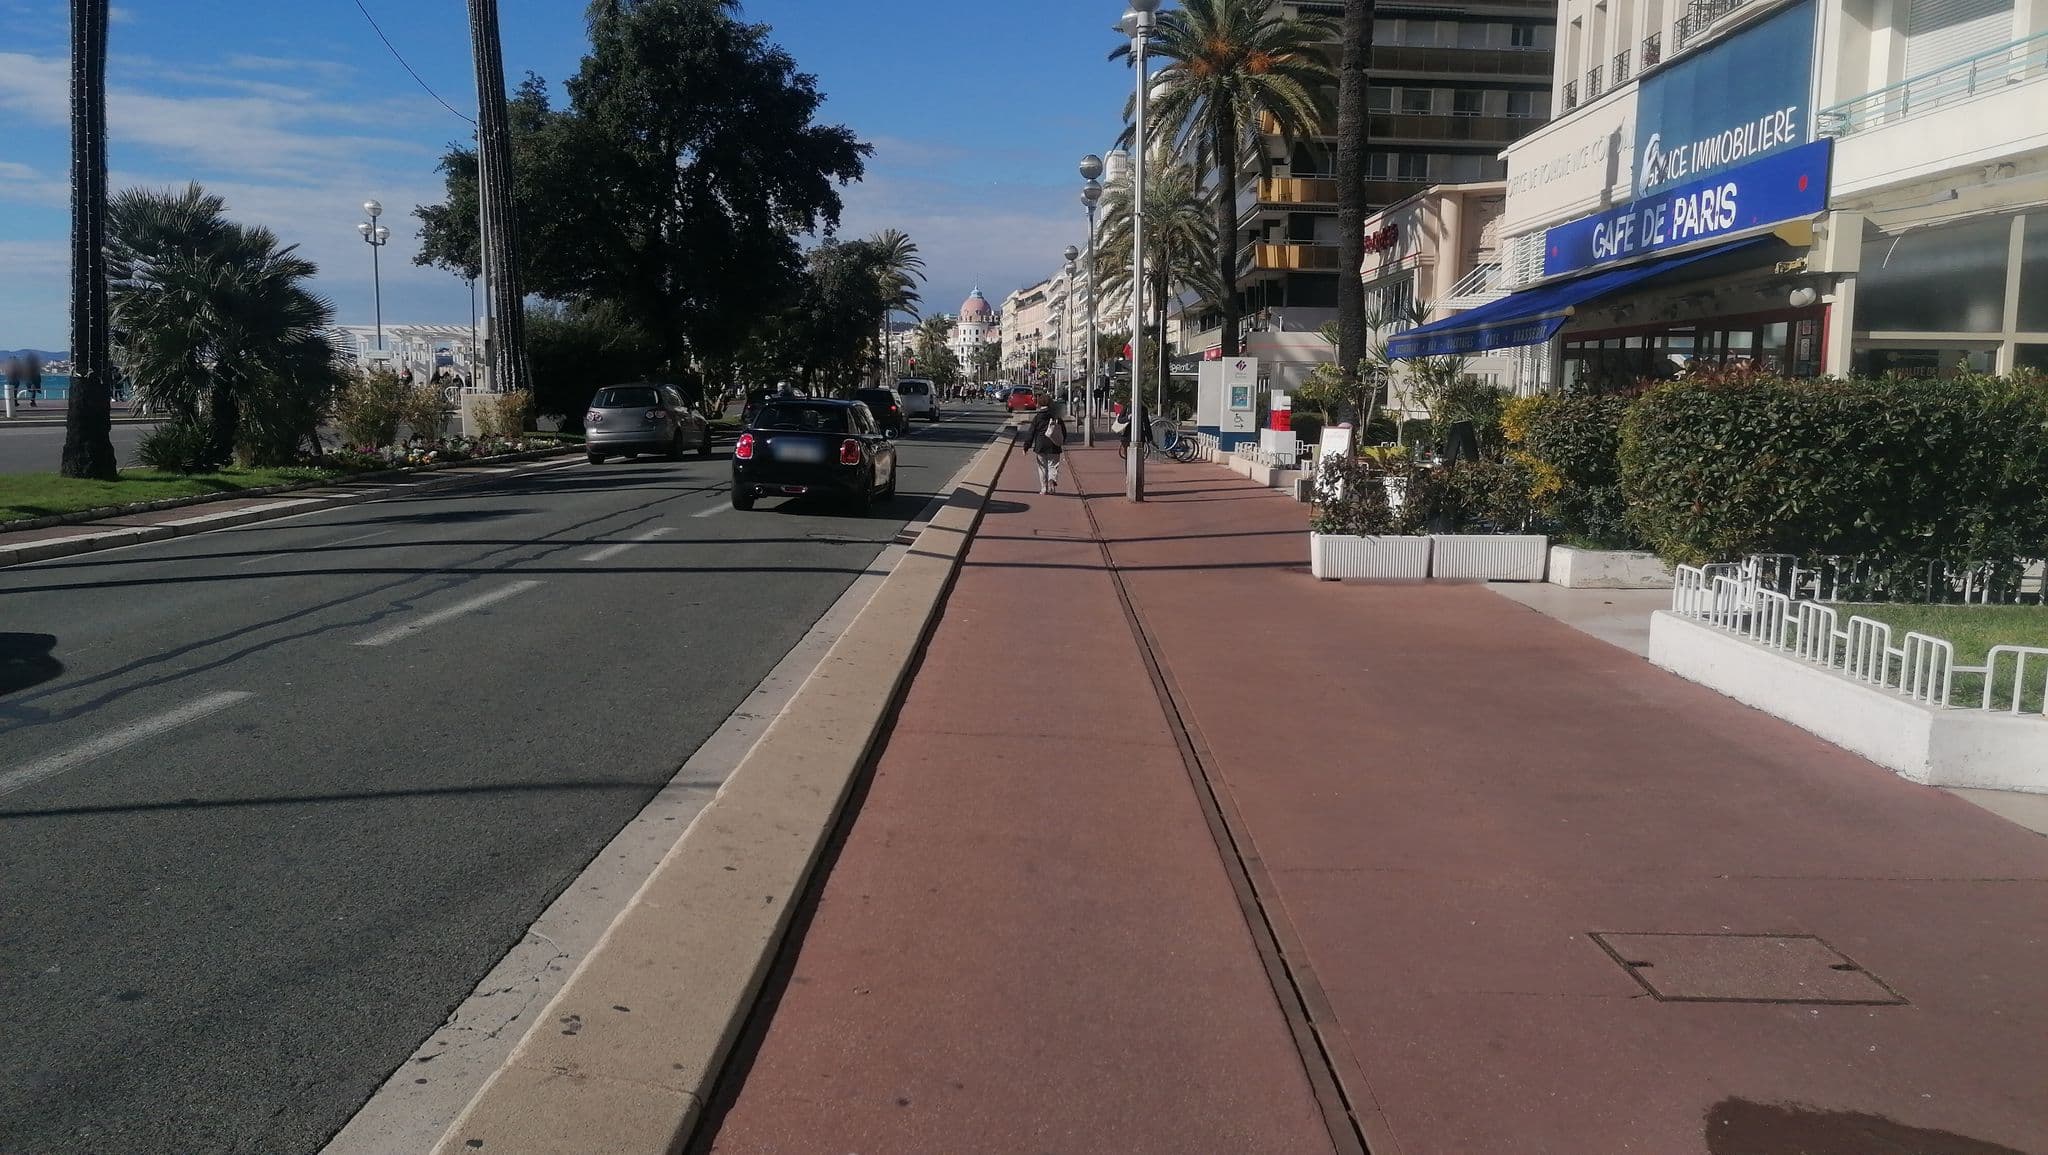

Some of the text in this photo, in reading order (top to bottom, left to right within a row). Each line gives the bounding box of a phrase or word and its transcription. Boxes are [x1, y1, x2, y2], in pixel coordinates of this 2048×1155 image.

[1691, 106, 1798, 174] IMMOBILIERE
[1592, 182, 1738, 259] CAFÉ DE PARIS
